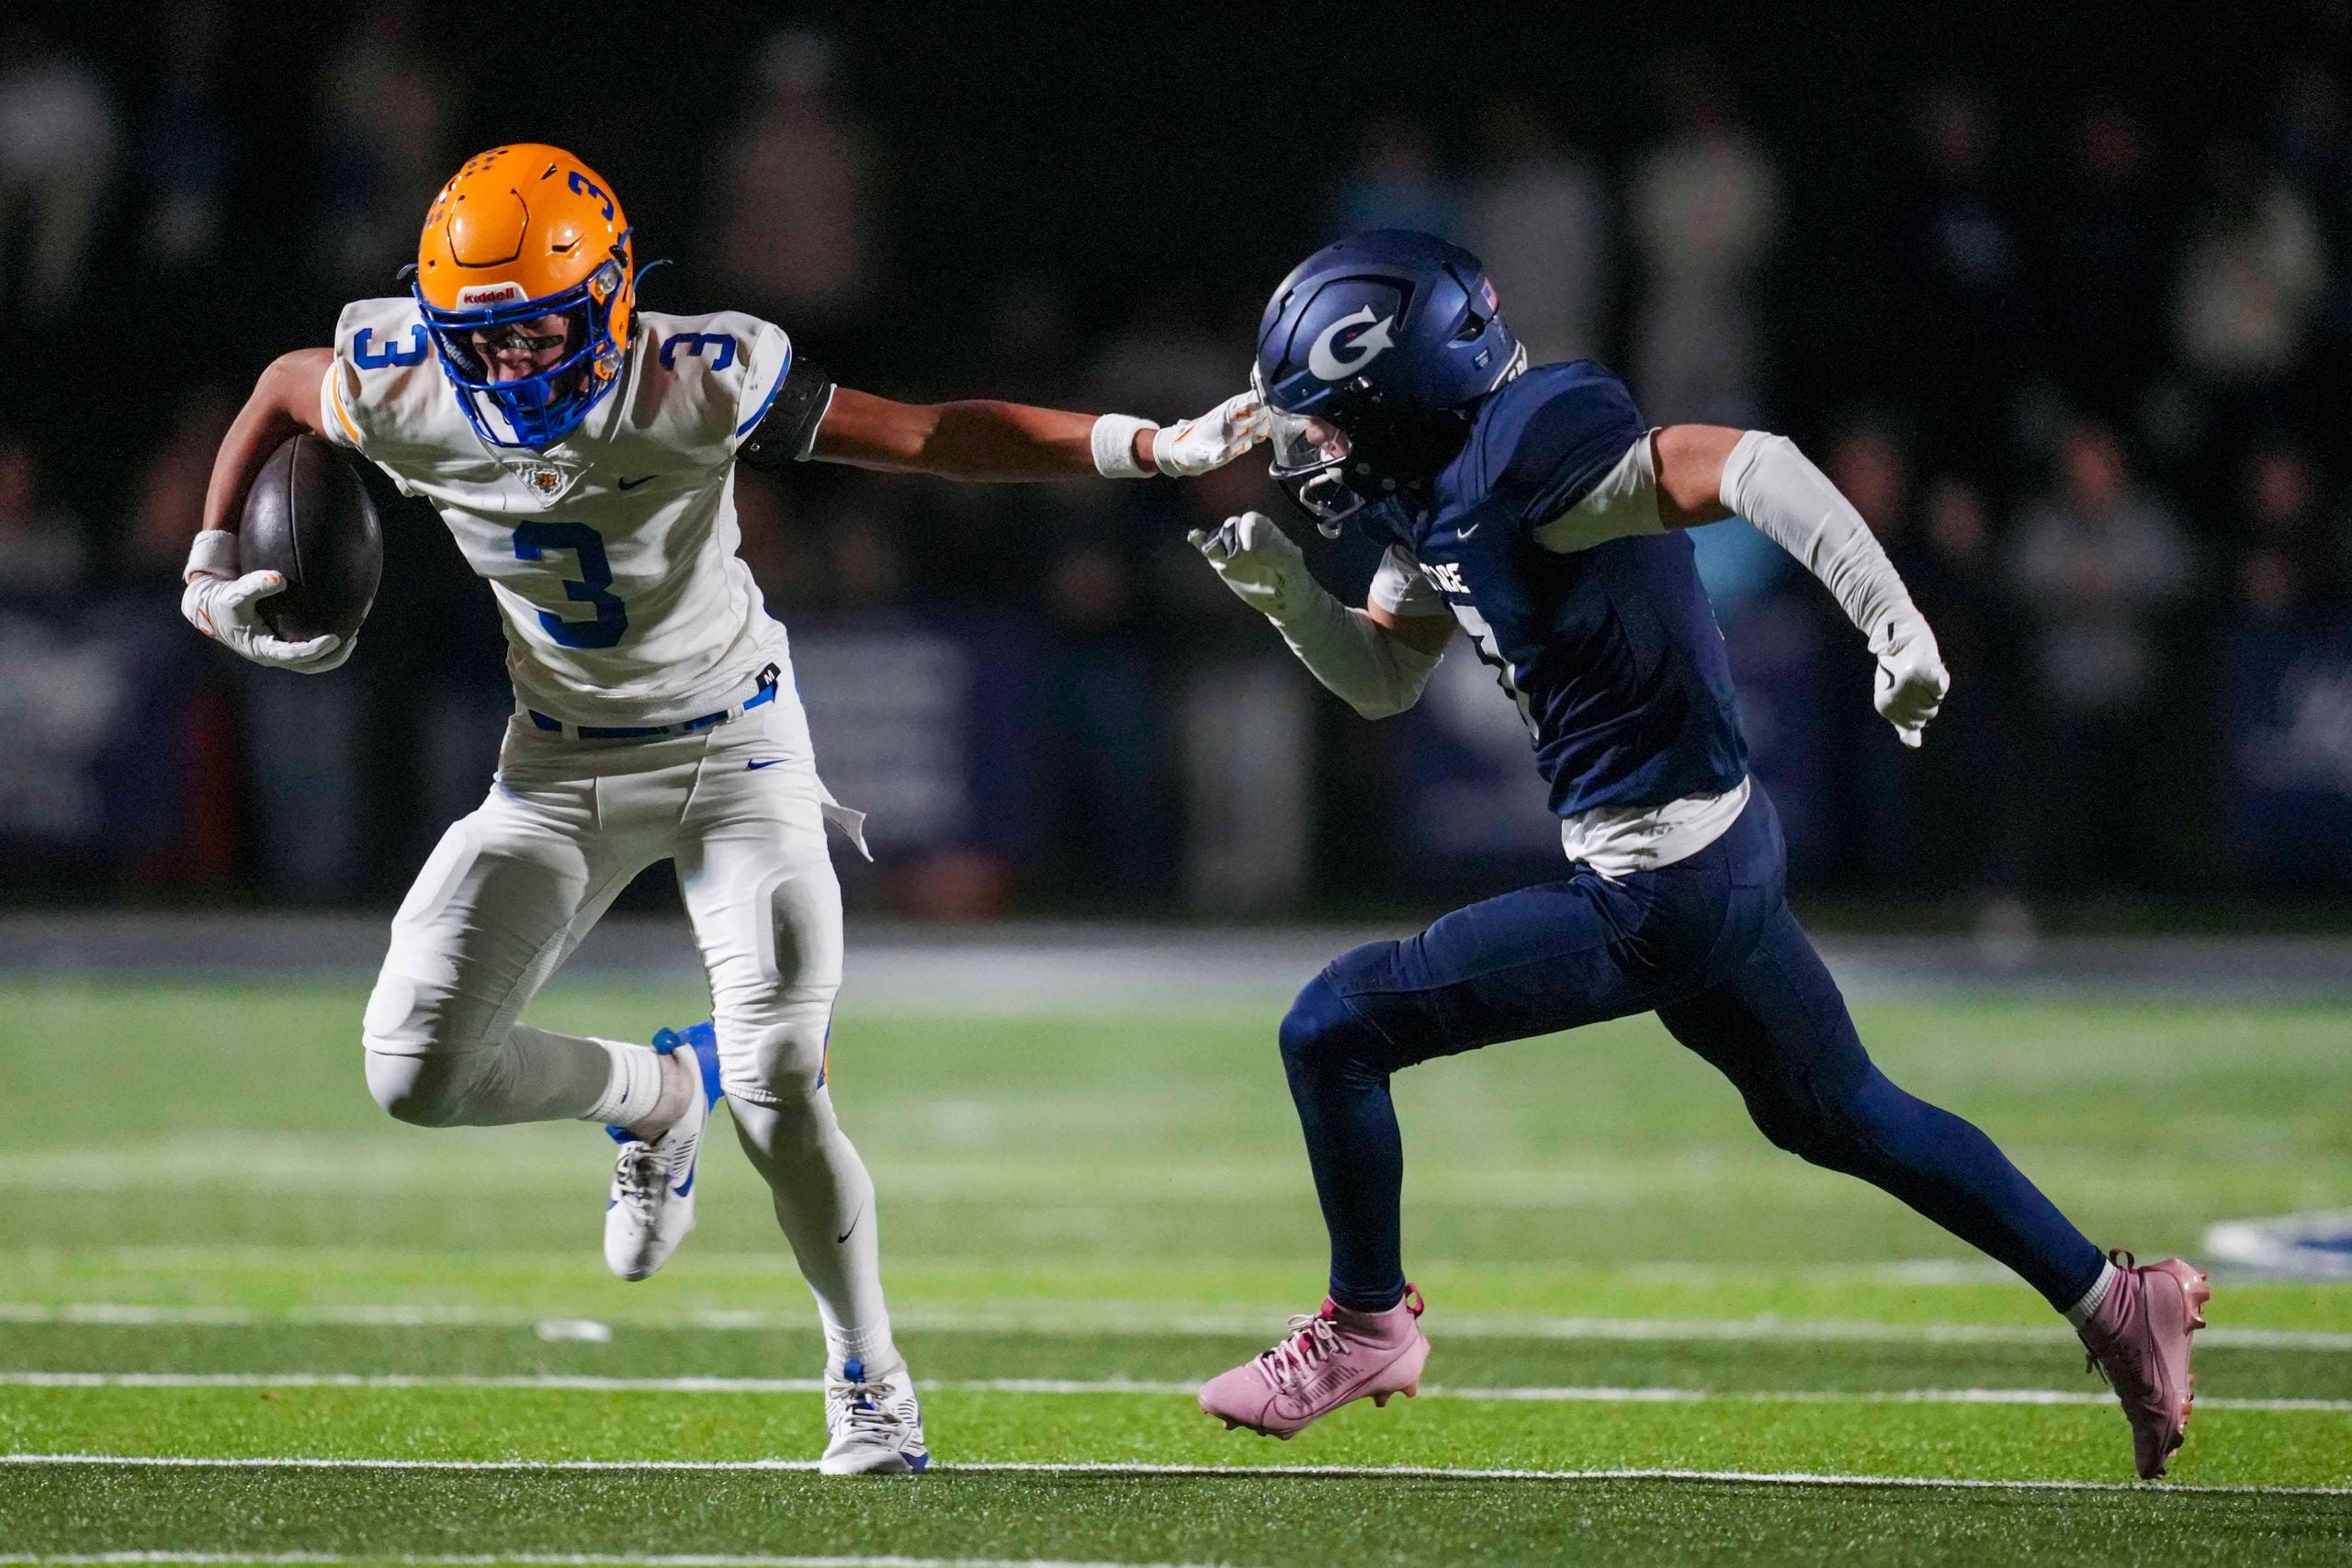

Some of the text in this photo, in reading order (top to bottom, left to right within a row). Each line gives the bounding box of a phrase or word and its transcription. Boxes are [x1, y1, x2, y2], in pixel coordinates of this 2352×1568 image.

[568, 170, 615, 221] 3
[464, 287, 514, 304] Riddell
[353, 323, 428, 371] 3
[659, 332, 736, 372] 3
[512, 520, 628, 649] 3
